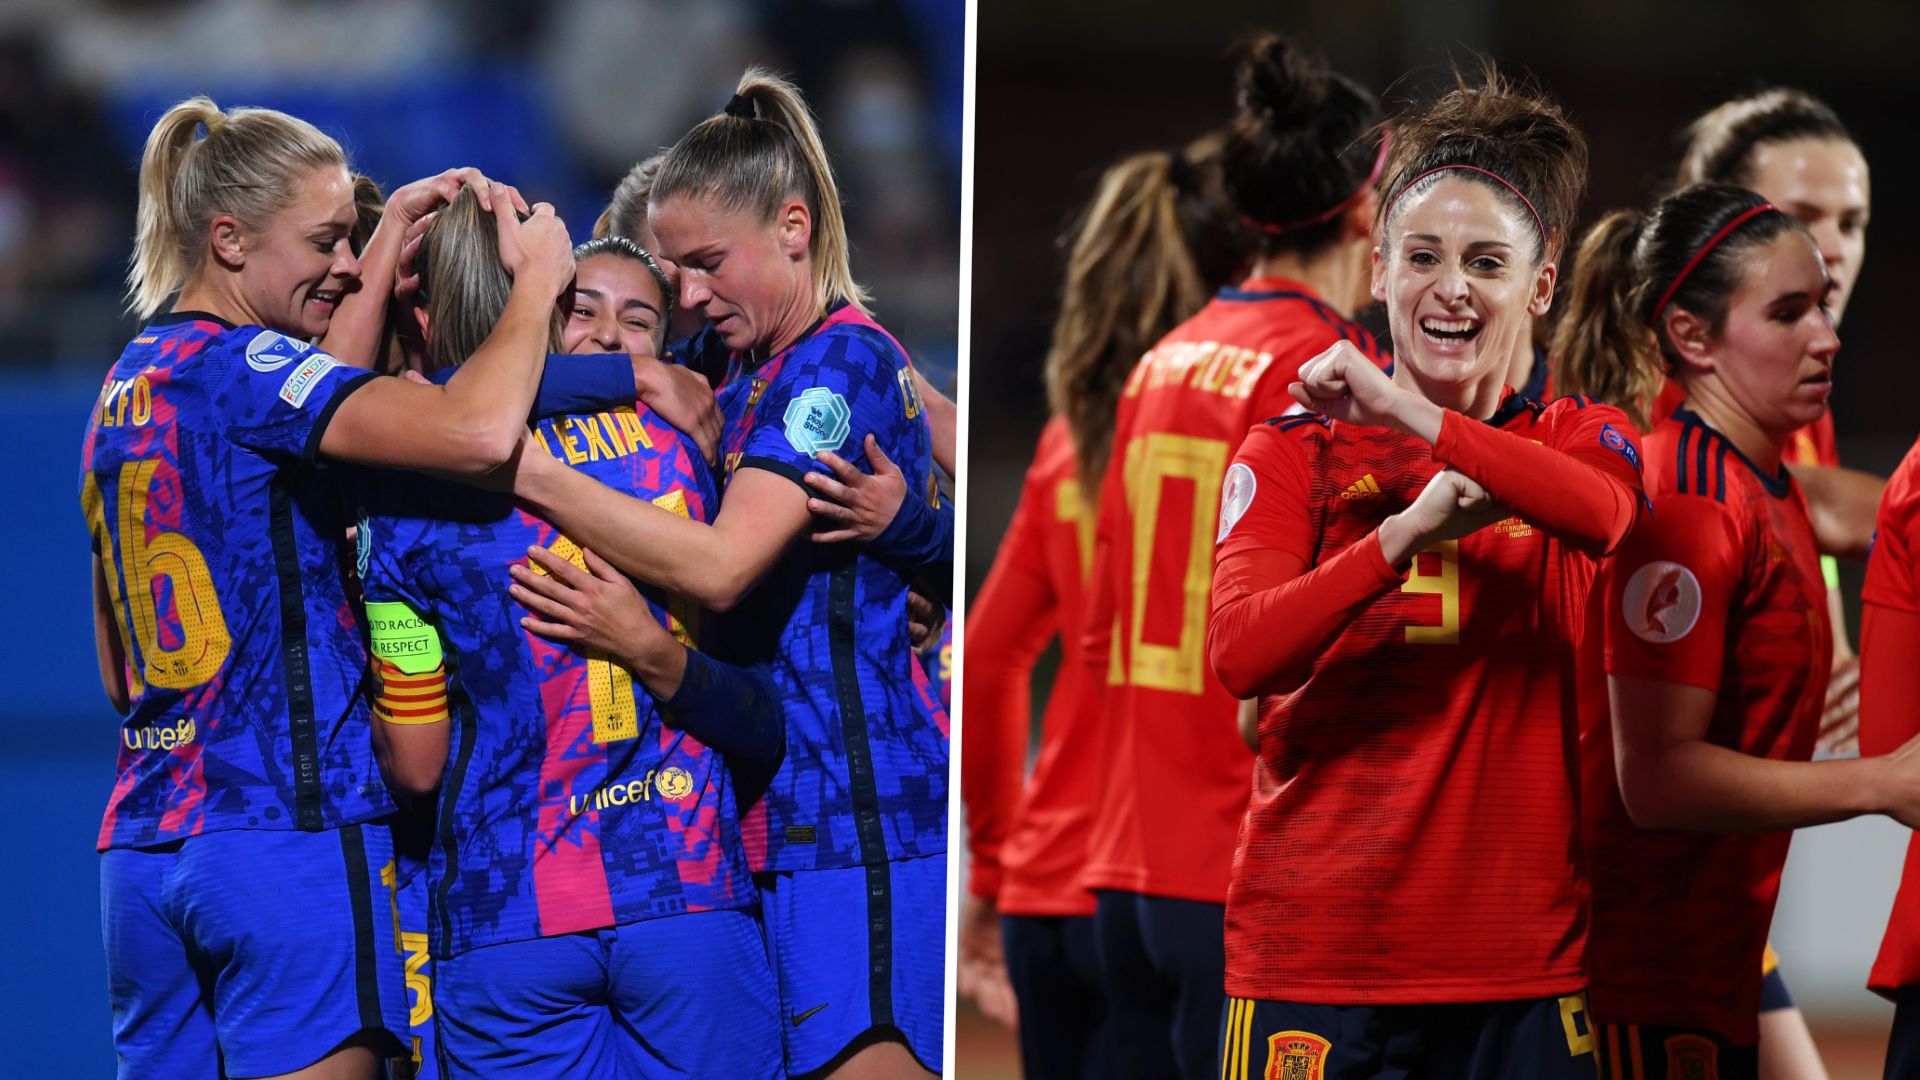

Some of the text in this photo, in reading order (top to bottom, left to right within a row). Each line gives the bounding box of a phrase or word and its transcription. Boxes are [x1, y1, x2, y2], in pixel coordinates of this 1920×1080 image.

[811, 406, 823, 418] We
[80, 458, 233, 697] 16
[1107, 431, 1230, 695] 10
[1400, 540, 1460, 644] 9
[389, 617, 428, 631] RACIS
[380, 638, 430, 654] RESPECT
[123, 719, 186, 751] unicef
[569, 768, 656, 818] unicef
